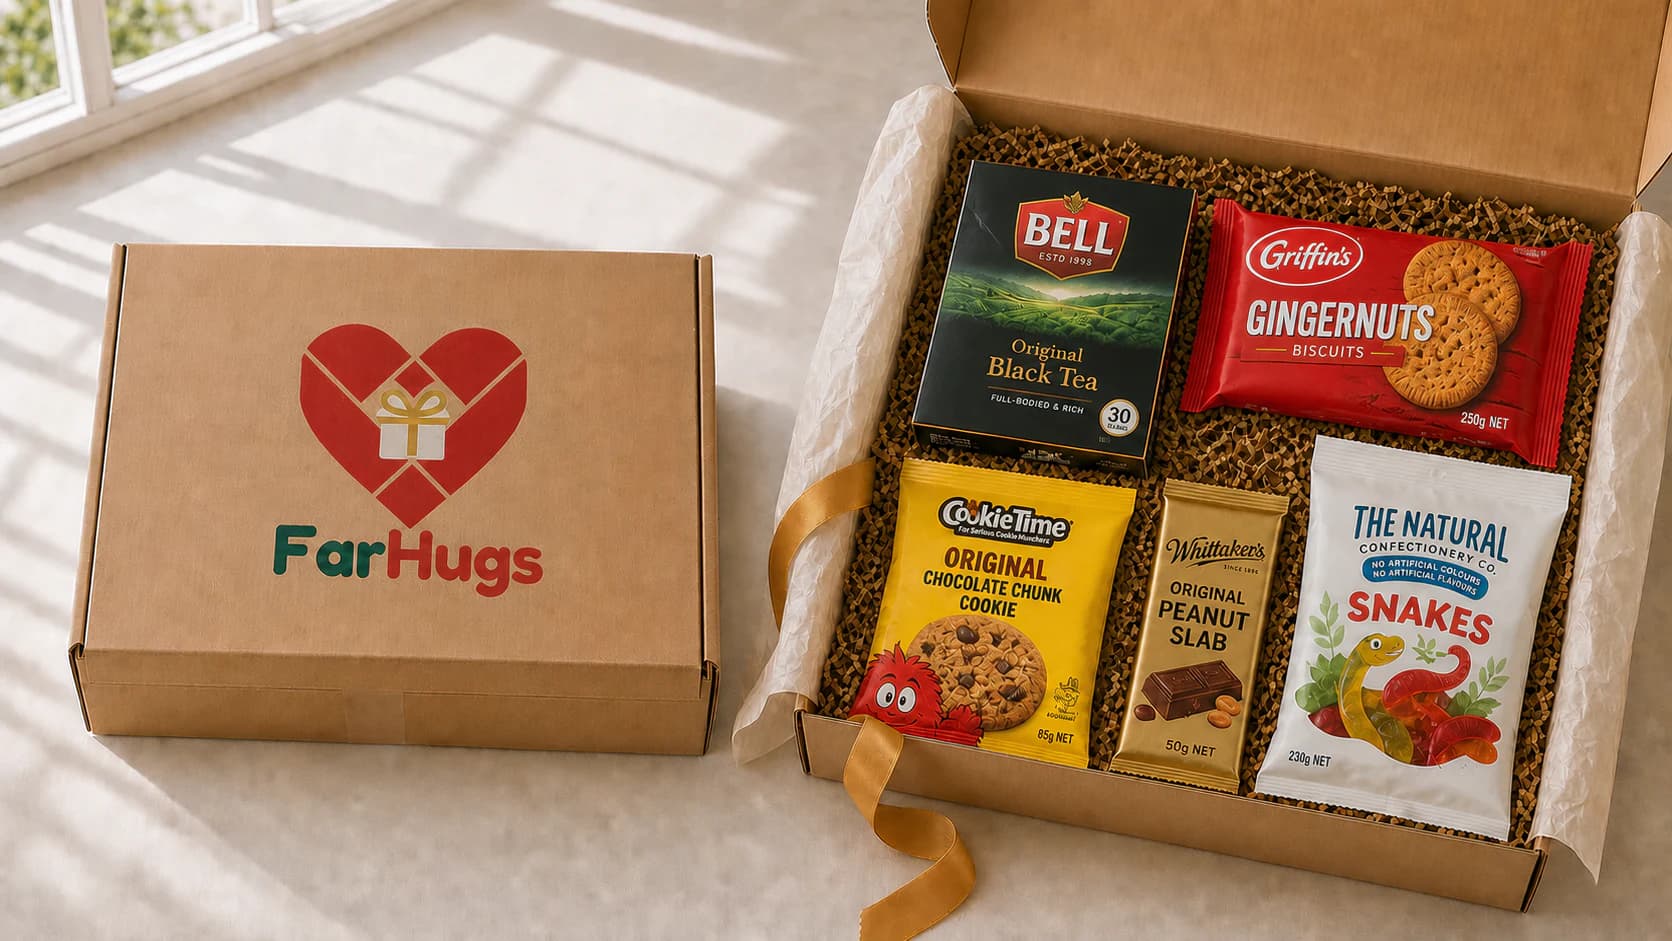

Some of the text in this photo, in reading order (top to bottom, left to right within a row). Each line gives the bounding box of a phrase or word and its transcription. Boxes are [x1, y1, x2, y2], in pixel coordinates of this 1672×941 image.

[1023, 212, 1114, 256] BELL
[1260, 239, 1353, 270] Griffin's
[1246, 299, 1436, 342] GINGERNUTS
[1011, 338, 1084, 362] Original
[1292, 344, 1365, 359] BISCUITS
[986, 355, 1098, 392] Black Tea
[990, 394, 1084, 414] FULL-BODIED & RICH
[1108, 406, 1131, 424] 30
[1460, 411, 1510, 430] 250g NET
[1354, 505, 1509, 564] THE NATURAL
[272, 523, 544, 598] FarHugs
[944, 546, 1048, 582] ORIGINAL
[1166, 536, 1266, 566] Whittaker's
[1359, 541, 1497, 576] CONFECTIONERY CO.
[1372, 570, 1386, 578] NO
[1388, 568, 1436, 581] ARTIFICIAL
[1388, 559, 1438, 571] ARTIFICIAL
[1440, 565, 1482, 586] COLOURS
[923, 570, 1062, 604] CHOCOLATE CHUNK
[1170, 581, 1246, 606] ORIGINAL
[960, 594, 1018, 618] COOKIE
[1158, 600, 1250, 632] PEANUT
[1347, 591, 1494, 646] SNAKES
[1170, 626, 1228, 652] SLAB
[1038, 728, 1074, 744] 85g NET
[1166, 740, 1216, 758] 50g NET
[1288, 750, 1332, 768] 230g NET
